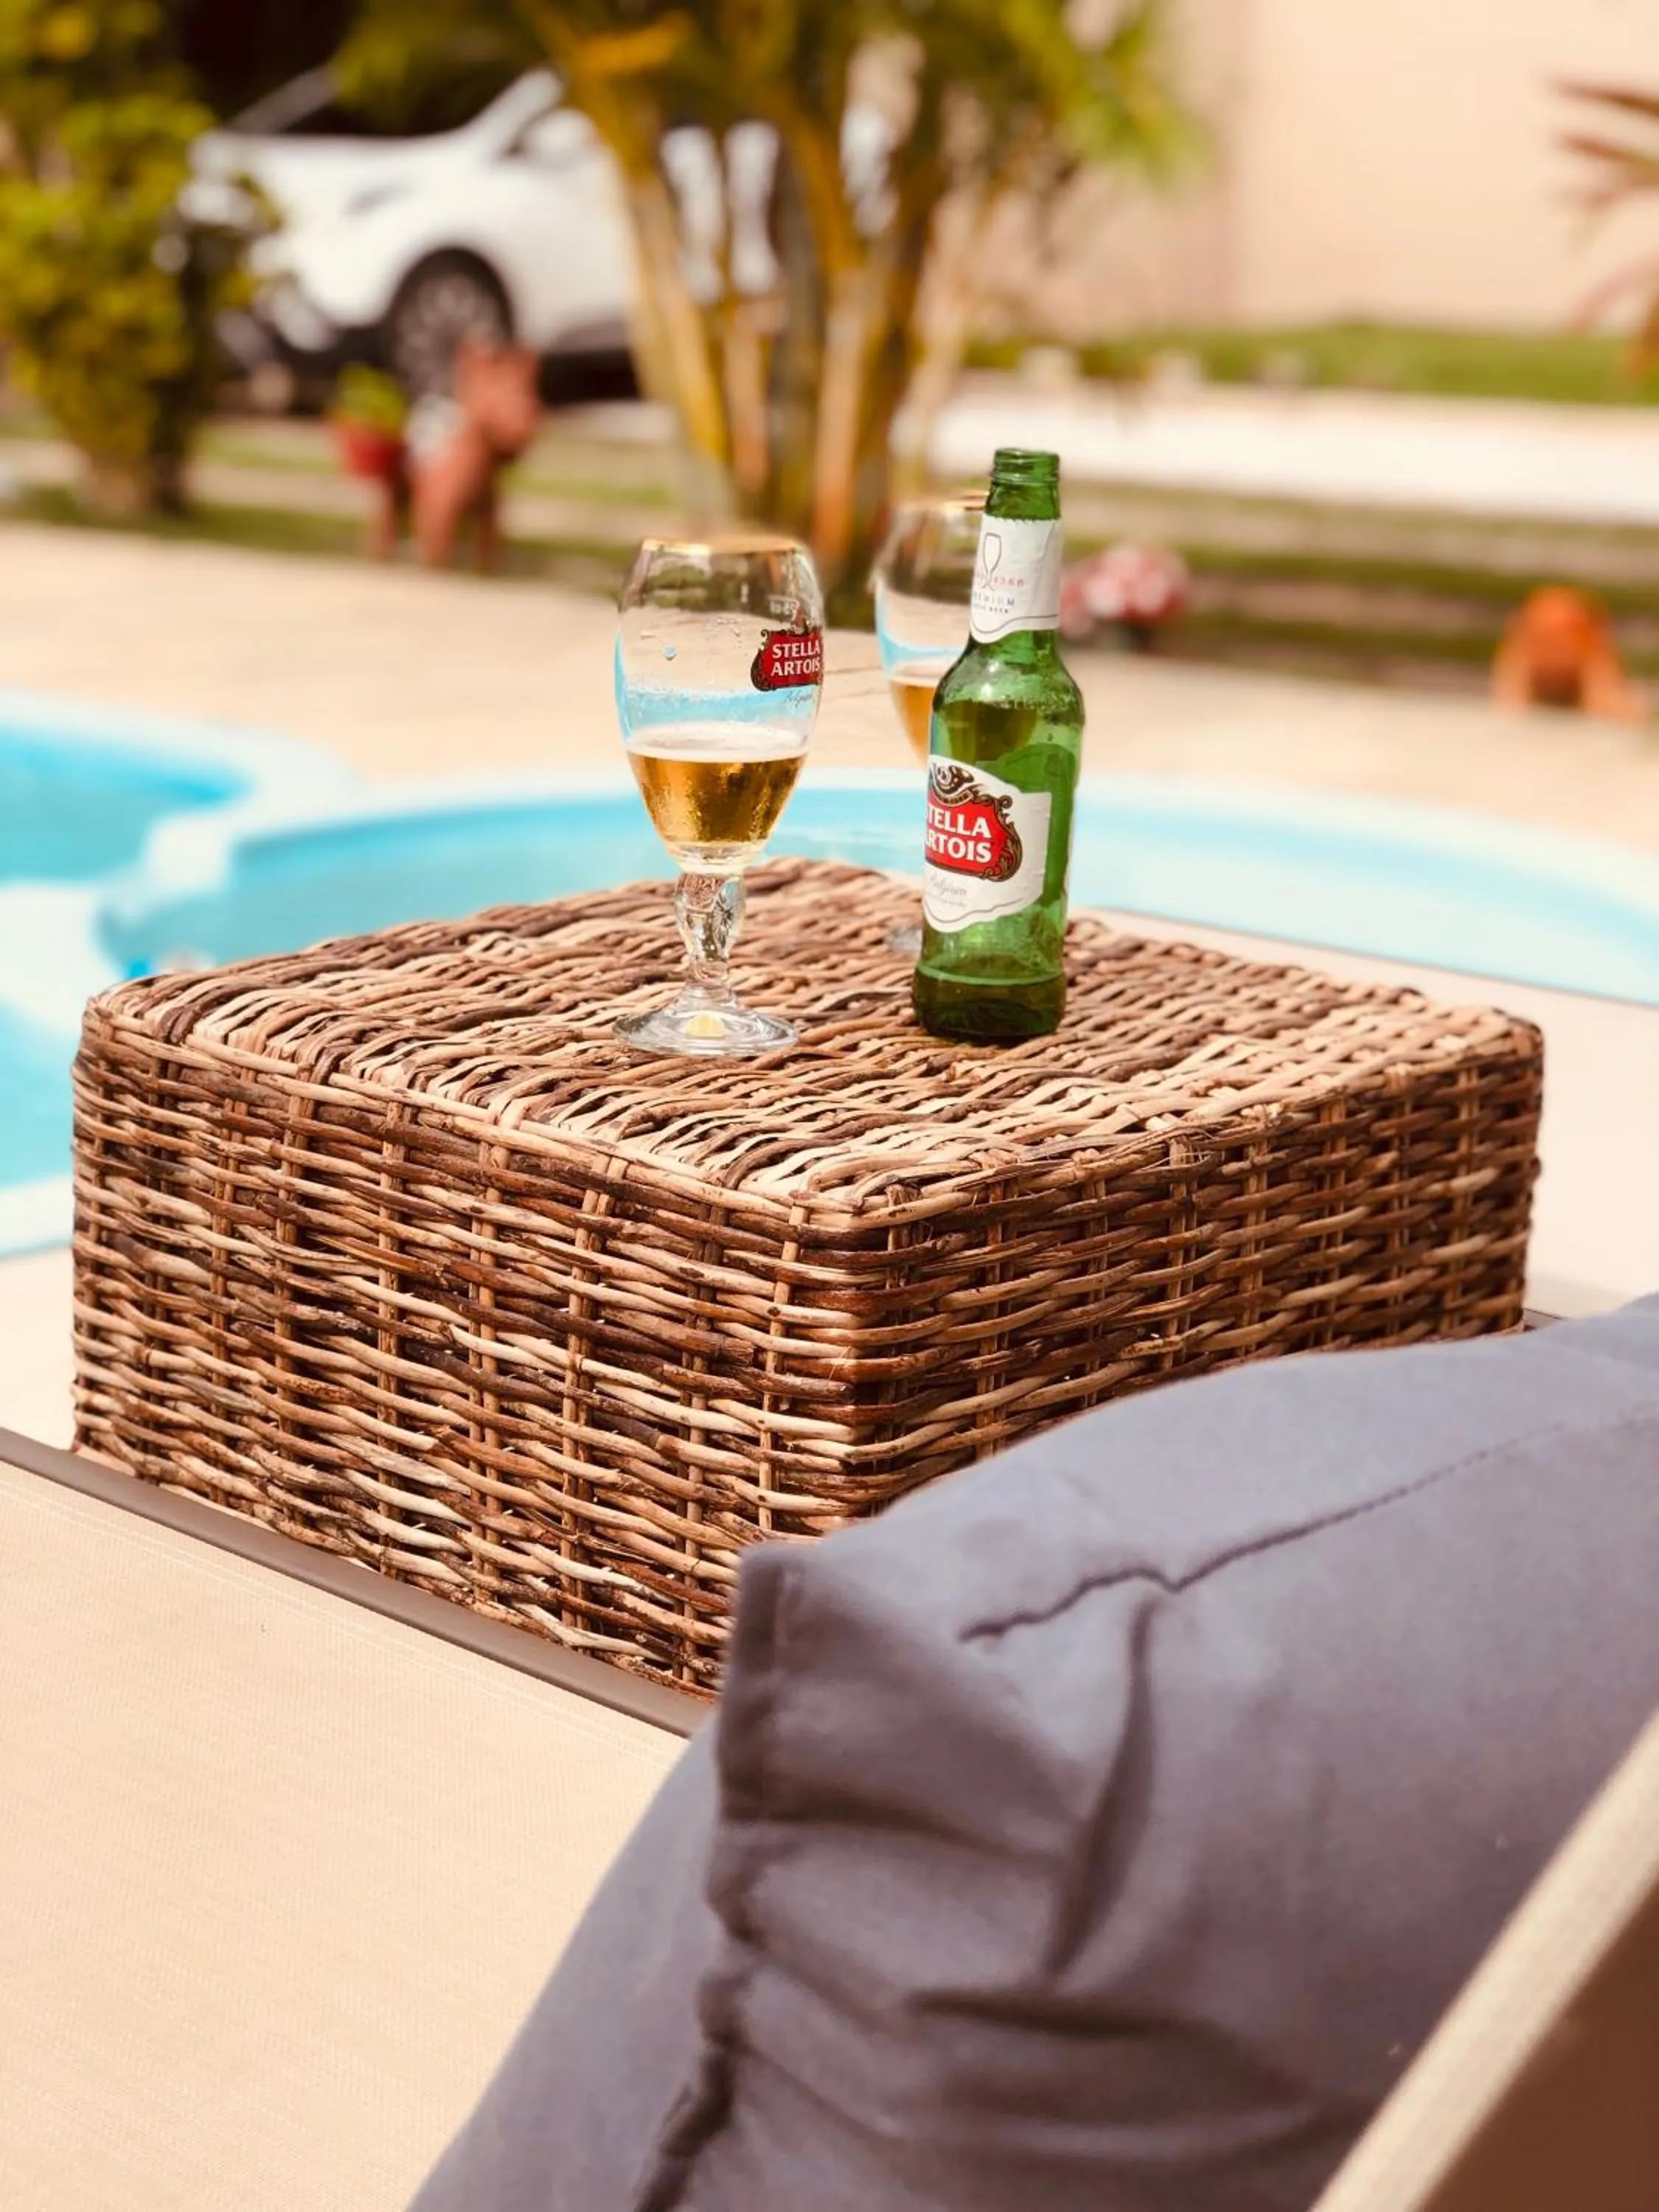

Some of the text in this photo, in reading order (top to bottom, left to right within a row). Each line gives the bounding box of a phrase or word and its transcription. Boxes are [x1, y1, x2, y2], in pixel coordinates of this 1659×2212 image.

[772, 639, 821, 658] STELLA
[771, 657, 821, 676] ARTOIS
[928, 803, 992, 838] TELLA
[925, 829, 992, 863] RTOIS
